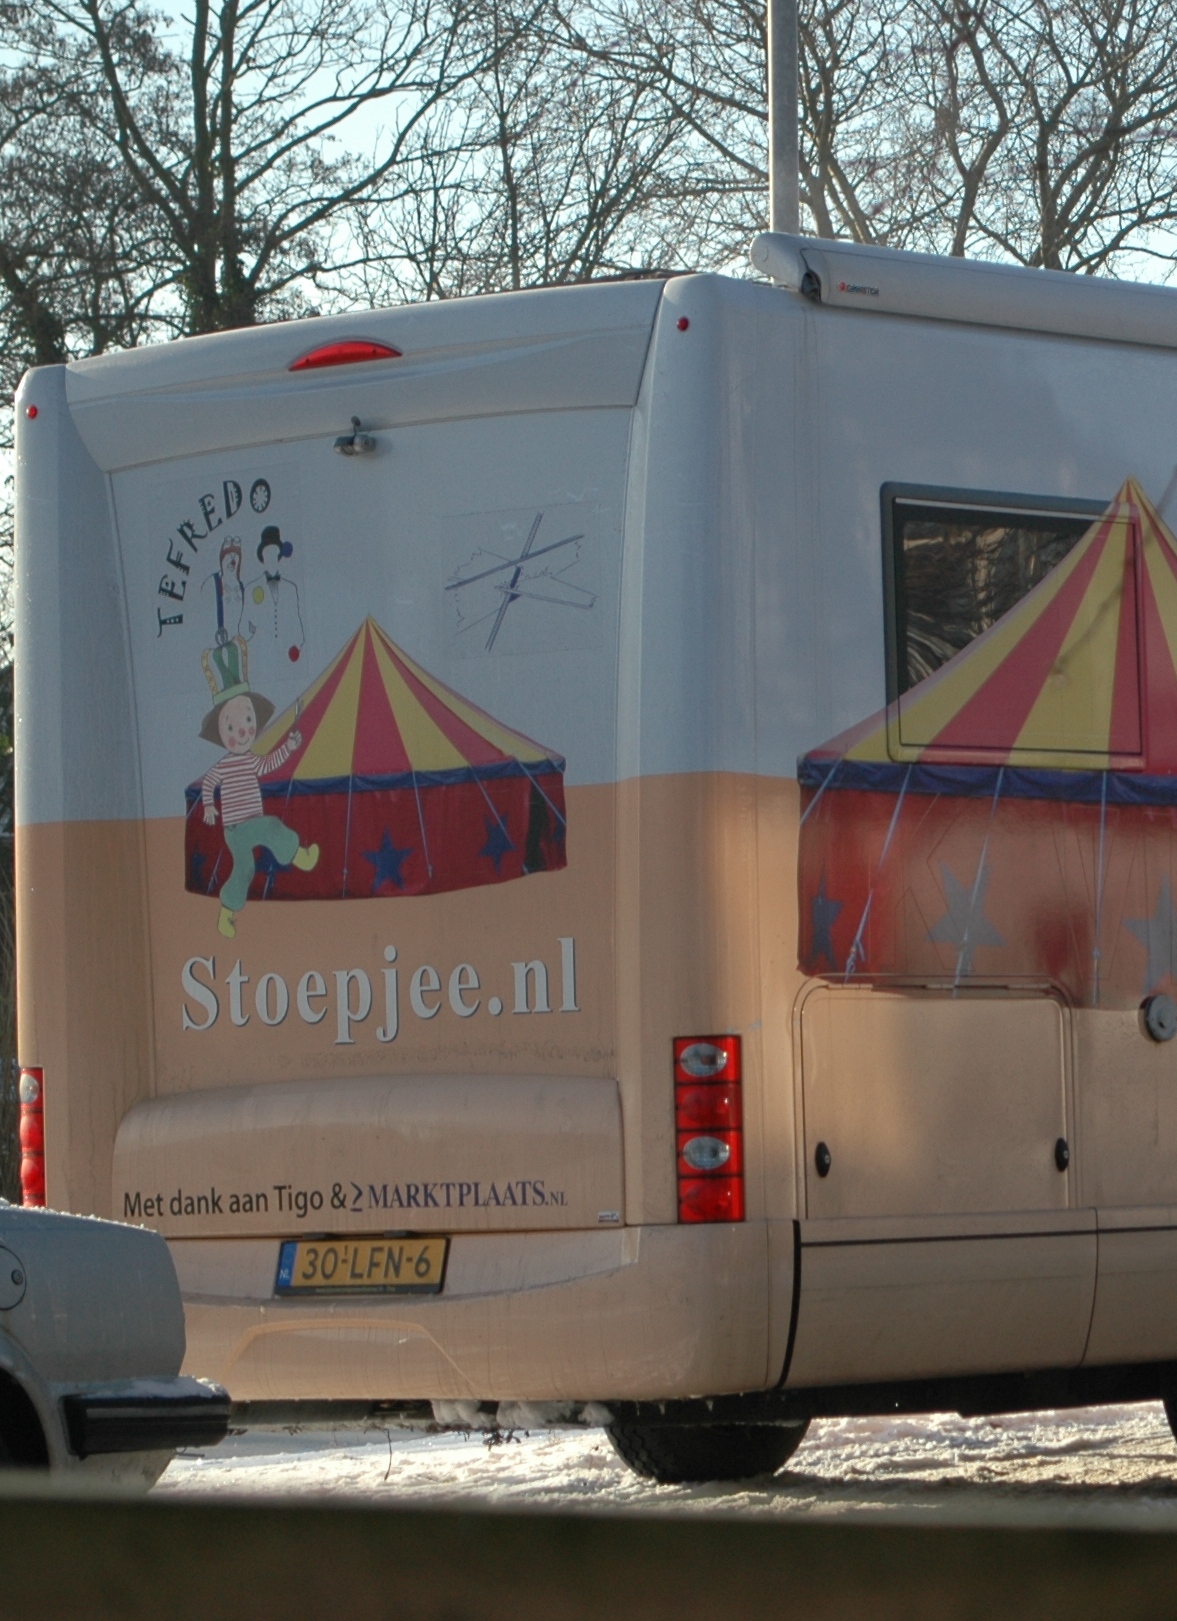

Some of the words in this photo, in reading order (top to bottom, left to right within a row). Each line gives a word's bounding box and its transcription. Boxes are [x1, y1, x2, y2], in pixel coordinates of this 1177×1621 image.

[156, 478, 271, 639] TEFREDO
[181, 936, 581, 1045] Stoepjee.nl
[123, 1191, 164, 1218] Met
[169, 1187, 224, 1217] dank
[228, 1191, 268, 1214] aan
[273, 1184, 324, 1219] Tigo
[330, 1182, 347, 1210] &
[301, 1245, 431, 1281] 30-LFN-6
